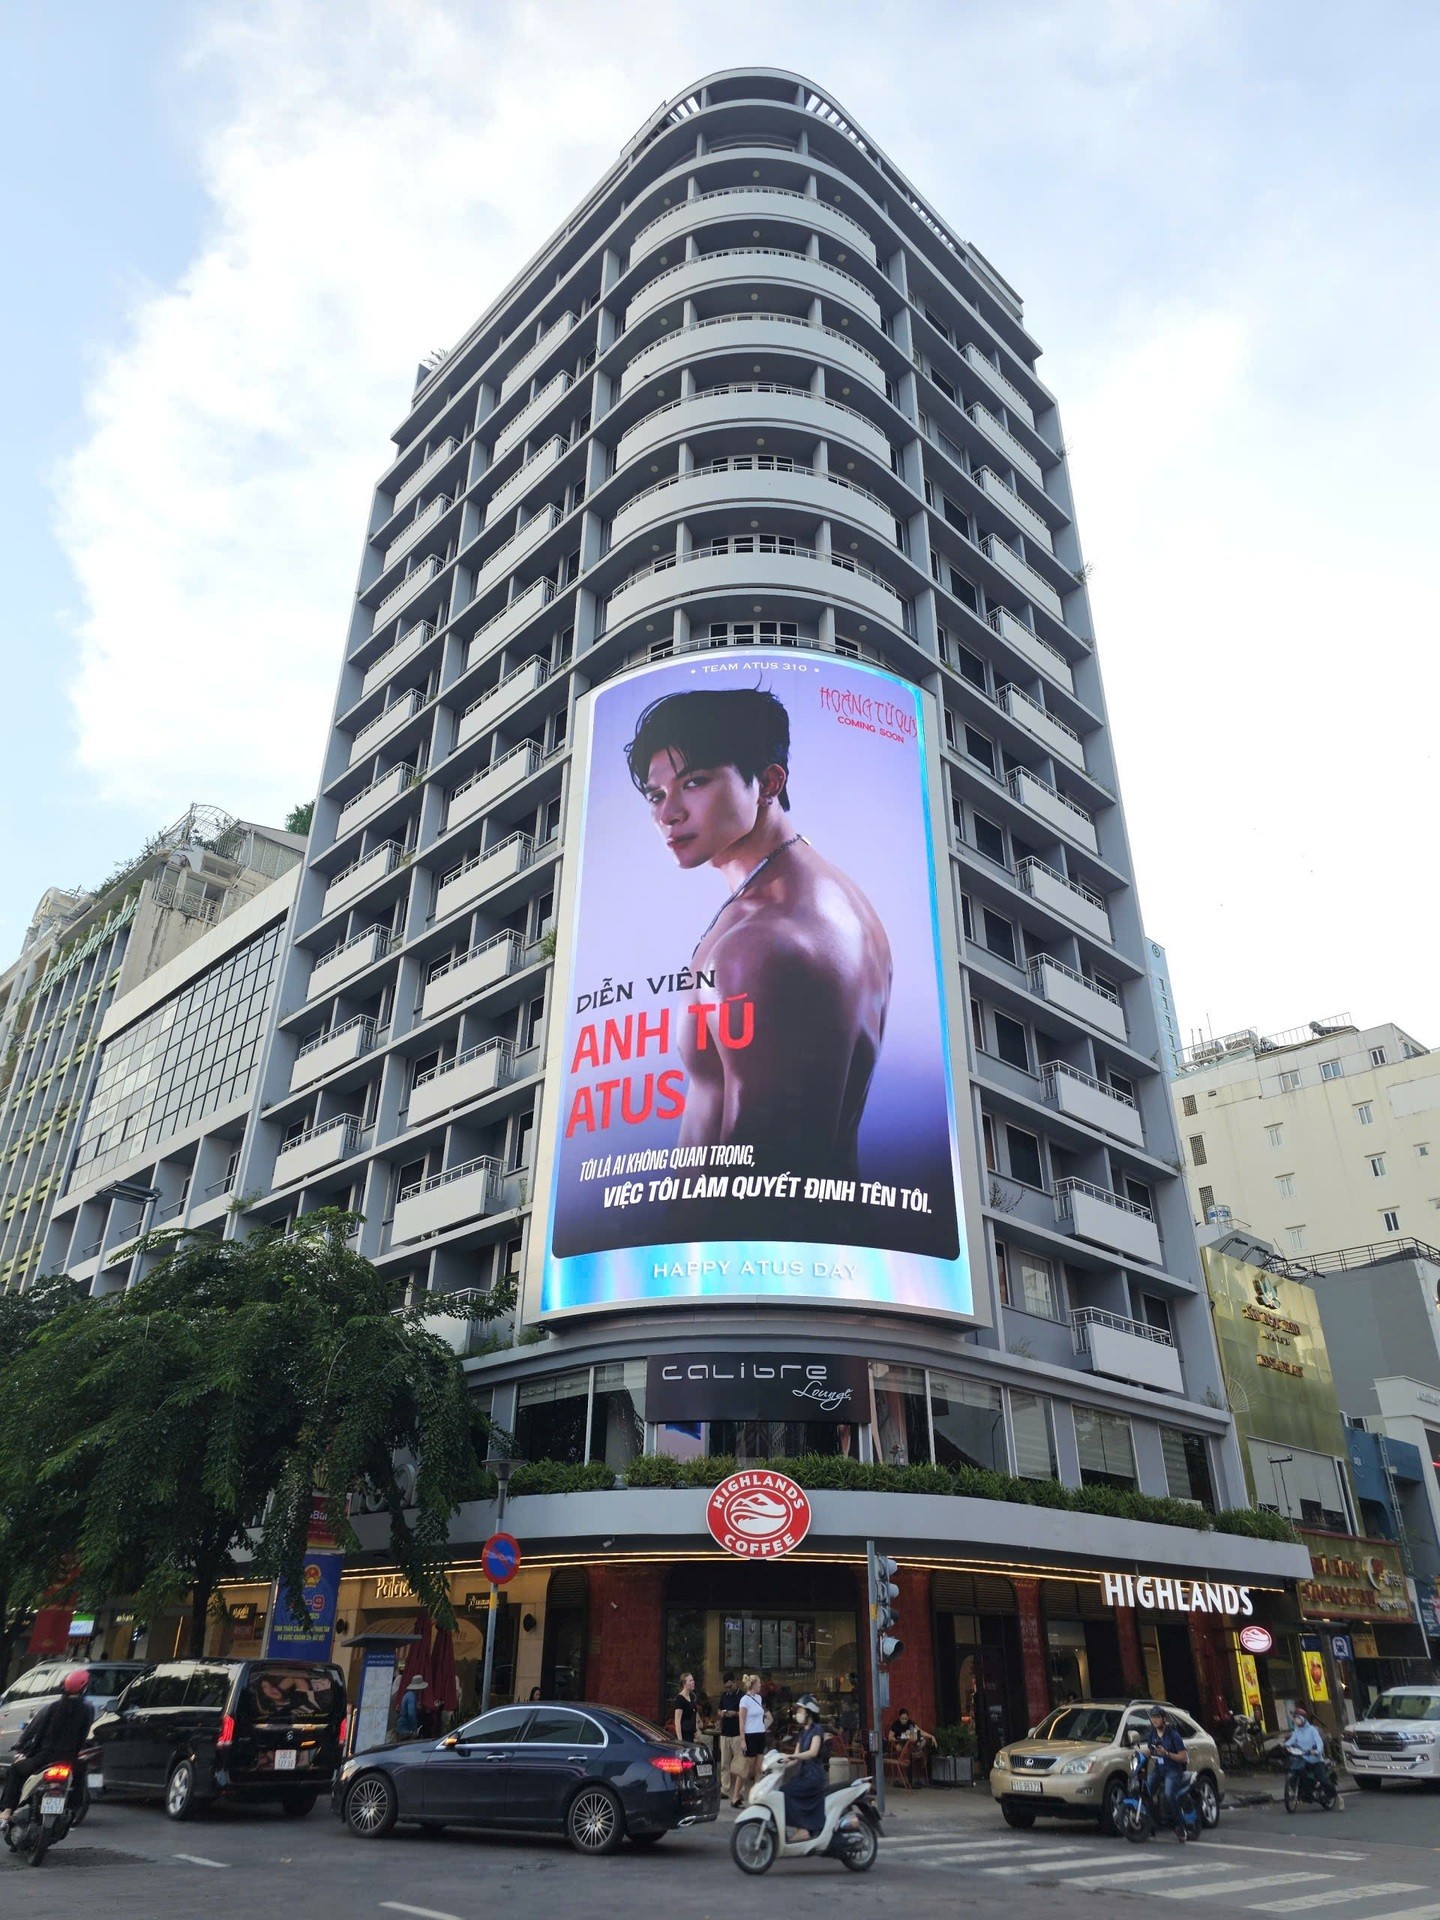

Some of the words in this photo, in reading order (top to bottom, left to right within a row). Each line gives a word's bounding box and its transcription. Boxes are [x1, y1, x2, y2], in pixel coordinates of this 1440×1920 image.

[702, 663, 739, 674] TEAM
[743, 661, 779, 670] ATUS
[782, 662, 808, 673] 310
[837, 716, 876, 733] COMING
[879, 728, 905, 744] SOON
[575, 977, 634, 1015] DIỄN
[646, 966, 717, 995] VIÊN
[570, 1008, 671, 1075] ANH
[687, 992, 756, 1051] TÚ
[565, 1069, 687, 1139] ATUS
[579, 1158, 598, 1182] TÔI
[596, 1154, 612, 1179] LÀ
[612, 1154, 626, 1176] AI
[625, 1148, 669, 1174] KHÔNG
[669, 1145, 708, 1170] QUAN
[708, 1144, 756, 1168] TRỌNG,
[603, 1180, 644, 1209] VIỆC
[648, 1176, 681, 1202] TÔI
[681, 1173, 729, 1200] LÀM
[731, 1170, 802, 1200] QUYẾT
[803, 1177, 857, 1203] ĐỊNH
[859, 1180, 898, 1208] TÊN
[899, 1187, 933, 1215] TÔI.
[653, 1260, 732, 1279] HAPPY
[740, 1259, 804, 1277] ATUS
[813, 1261, 858, 1280] DAY
[792, 1380, 854, 1412] Lounge
[712, 1474, 805, 1510] HIGHLANDS
[723, 1532, 796, 1555] COFFEE
[1102, 1572, 1254, 1616] HIGHLANDS
